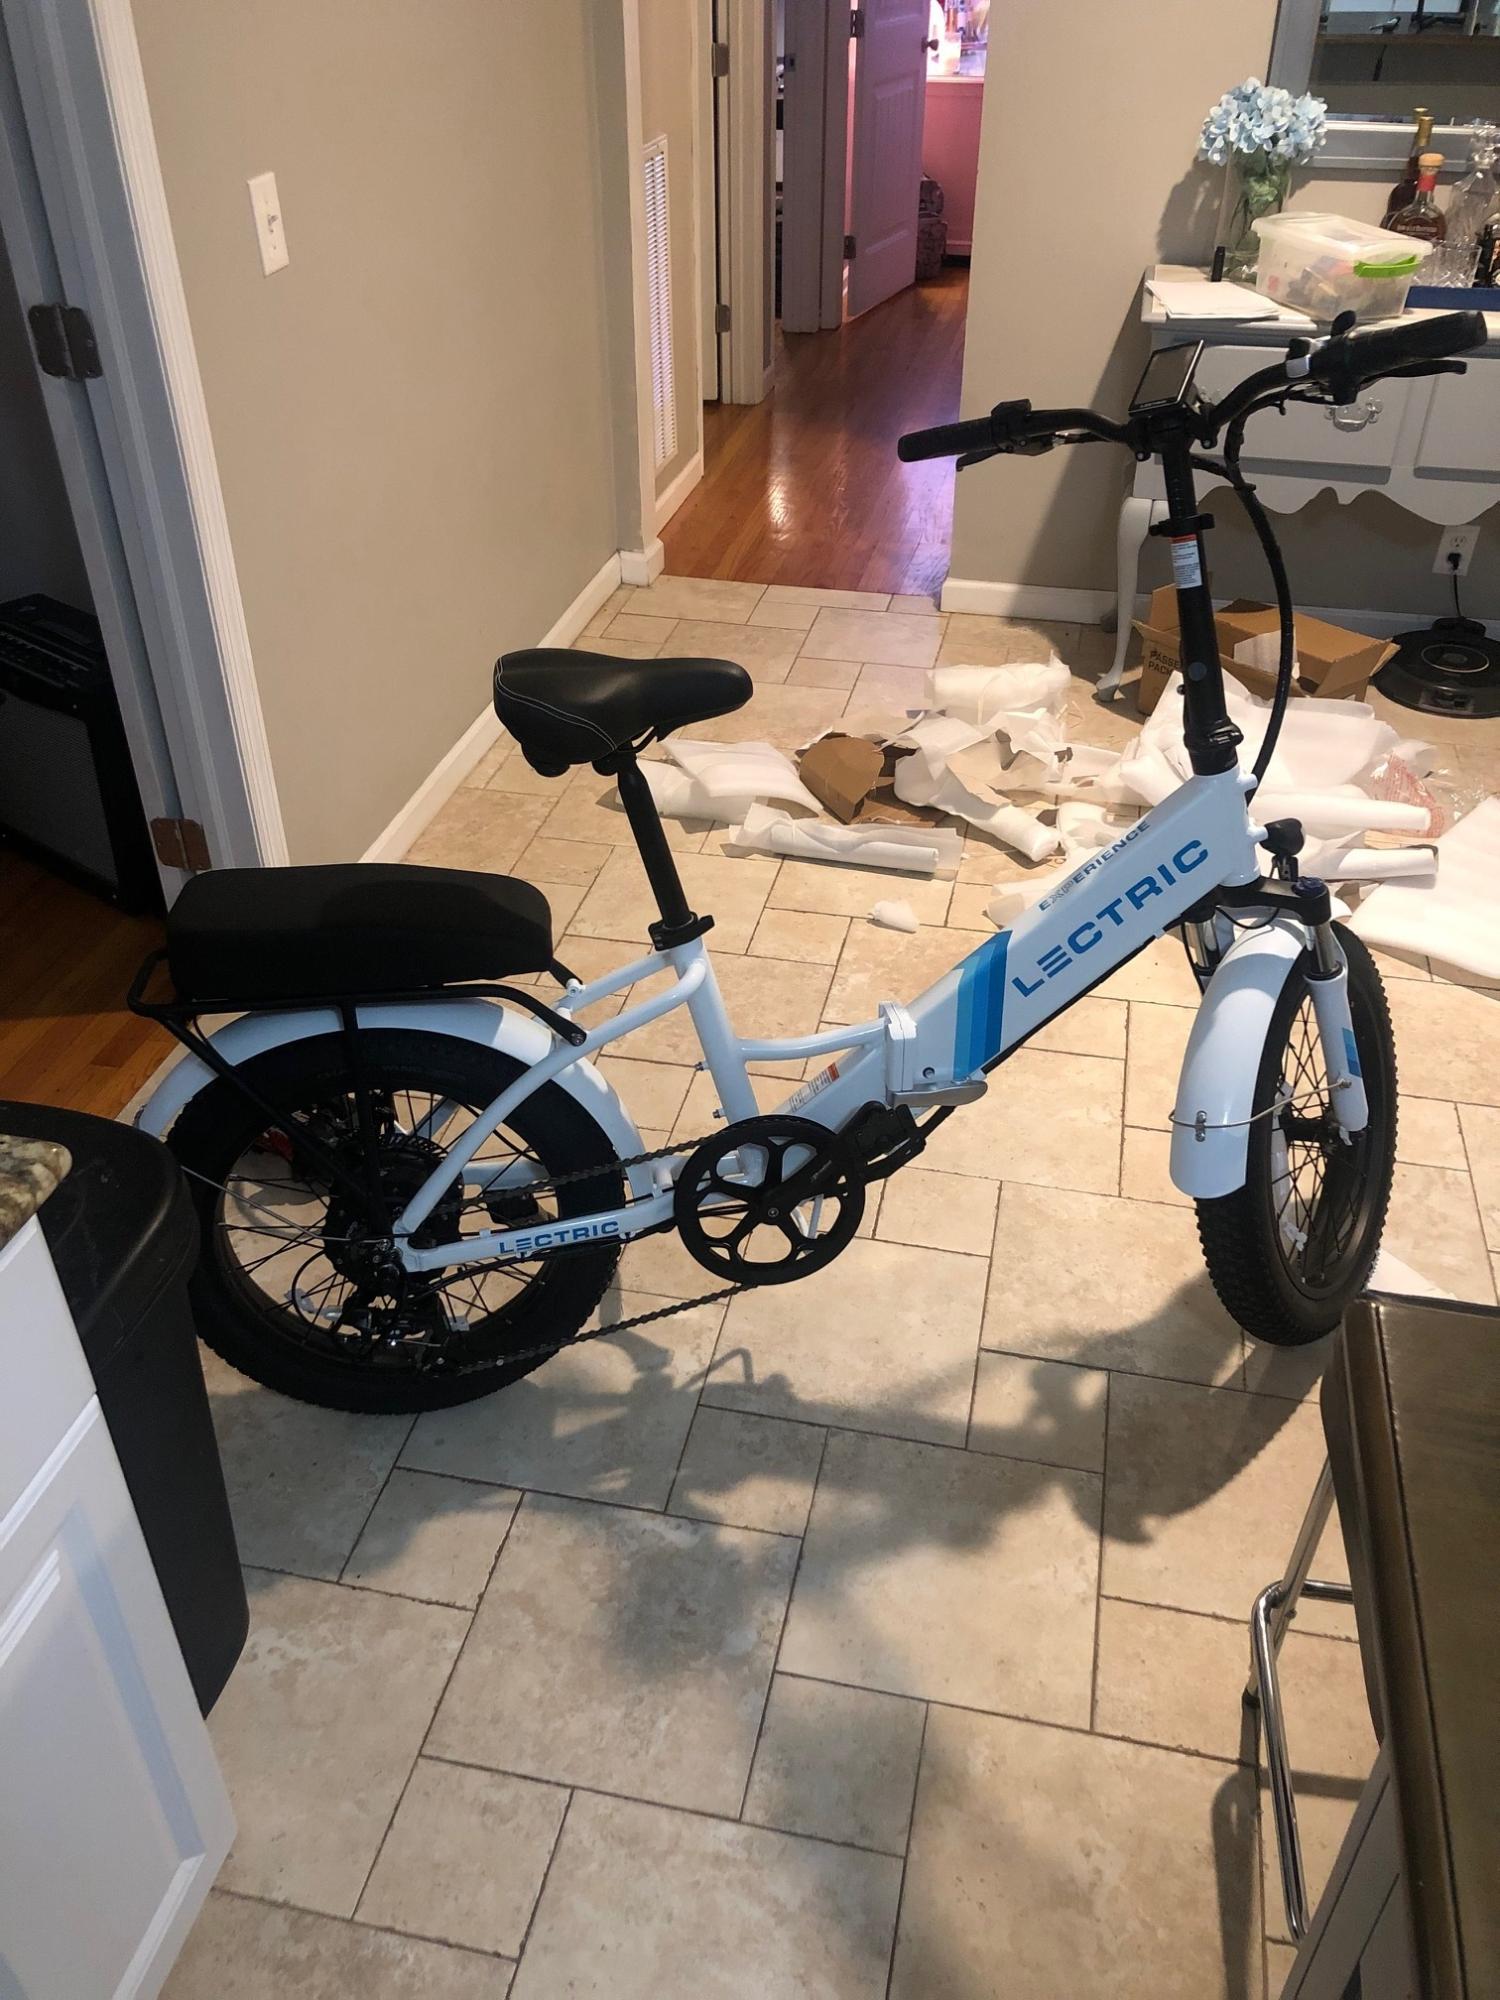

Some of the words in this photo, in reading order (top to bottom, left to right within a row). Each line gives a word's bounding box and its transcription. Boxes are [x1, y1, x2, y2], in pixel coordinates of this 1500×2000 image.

[1039, 820, 1151, 912] EXPERIENCE
[1011, 839, 1209, 998] LECTRIC
[499, 1220, 619, 1254] LECTRIC
